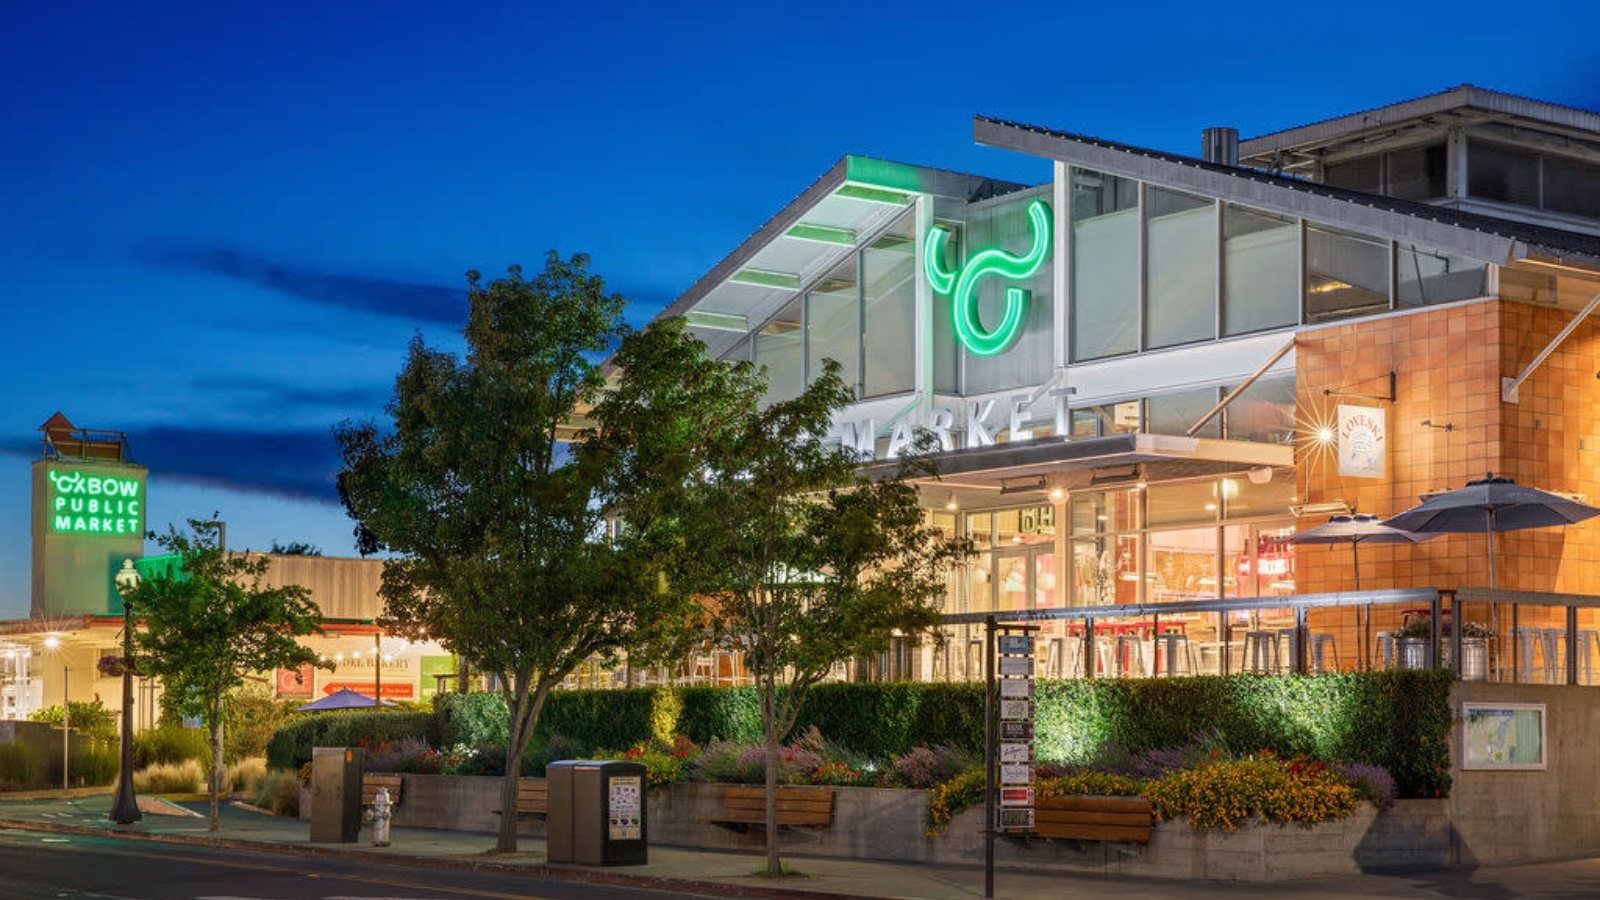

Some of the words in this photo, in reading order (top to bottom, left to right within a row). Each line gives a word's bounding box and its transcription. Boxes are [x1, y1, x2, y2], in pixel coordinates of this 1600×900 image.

[842, 387, 1077, 461] MARKET
[1342, 414, 1384, 442] LOVESKI
[50, 470, 138, 497] OXBOW
[56, 497, 139, 516] PUBLIC
[55, 515, 139, 533] MARKET
[366, 658, 411, 669] BKERY
